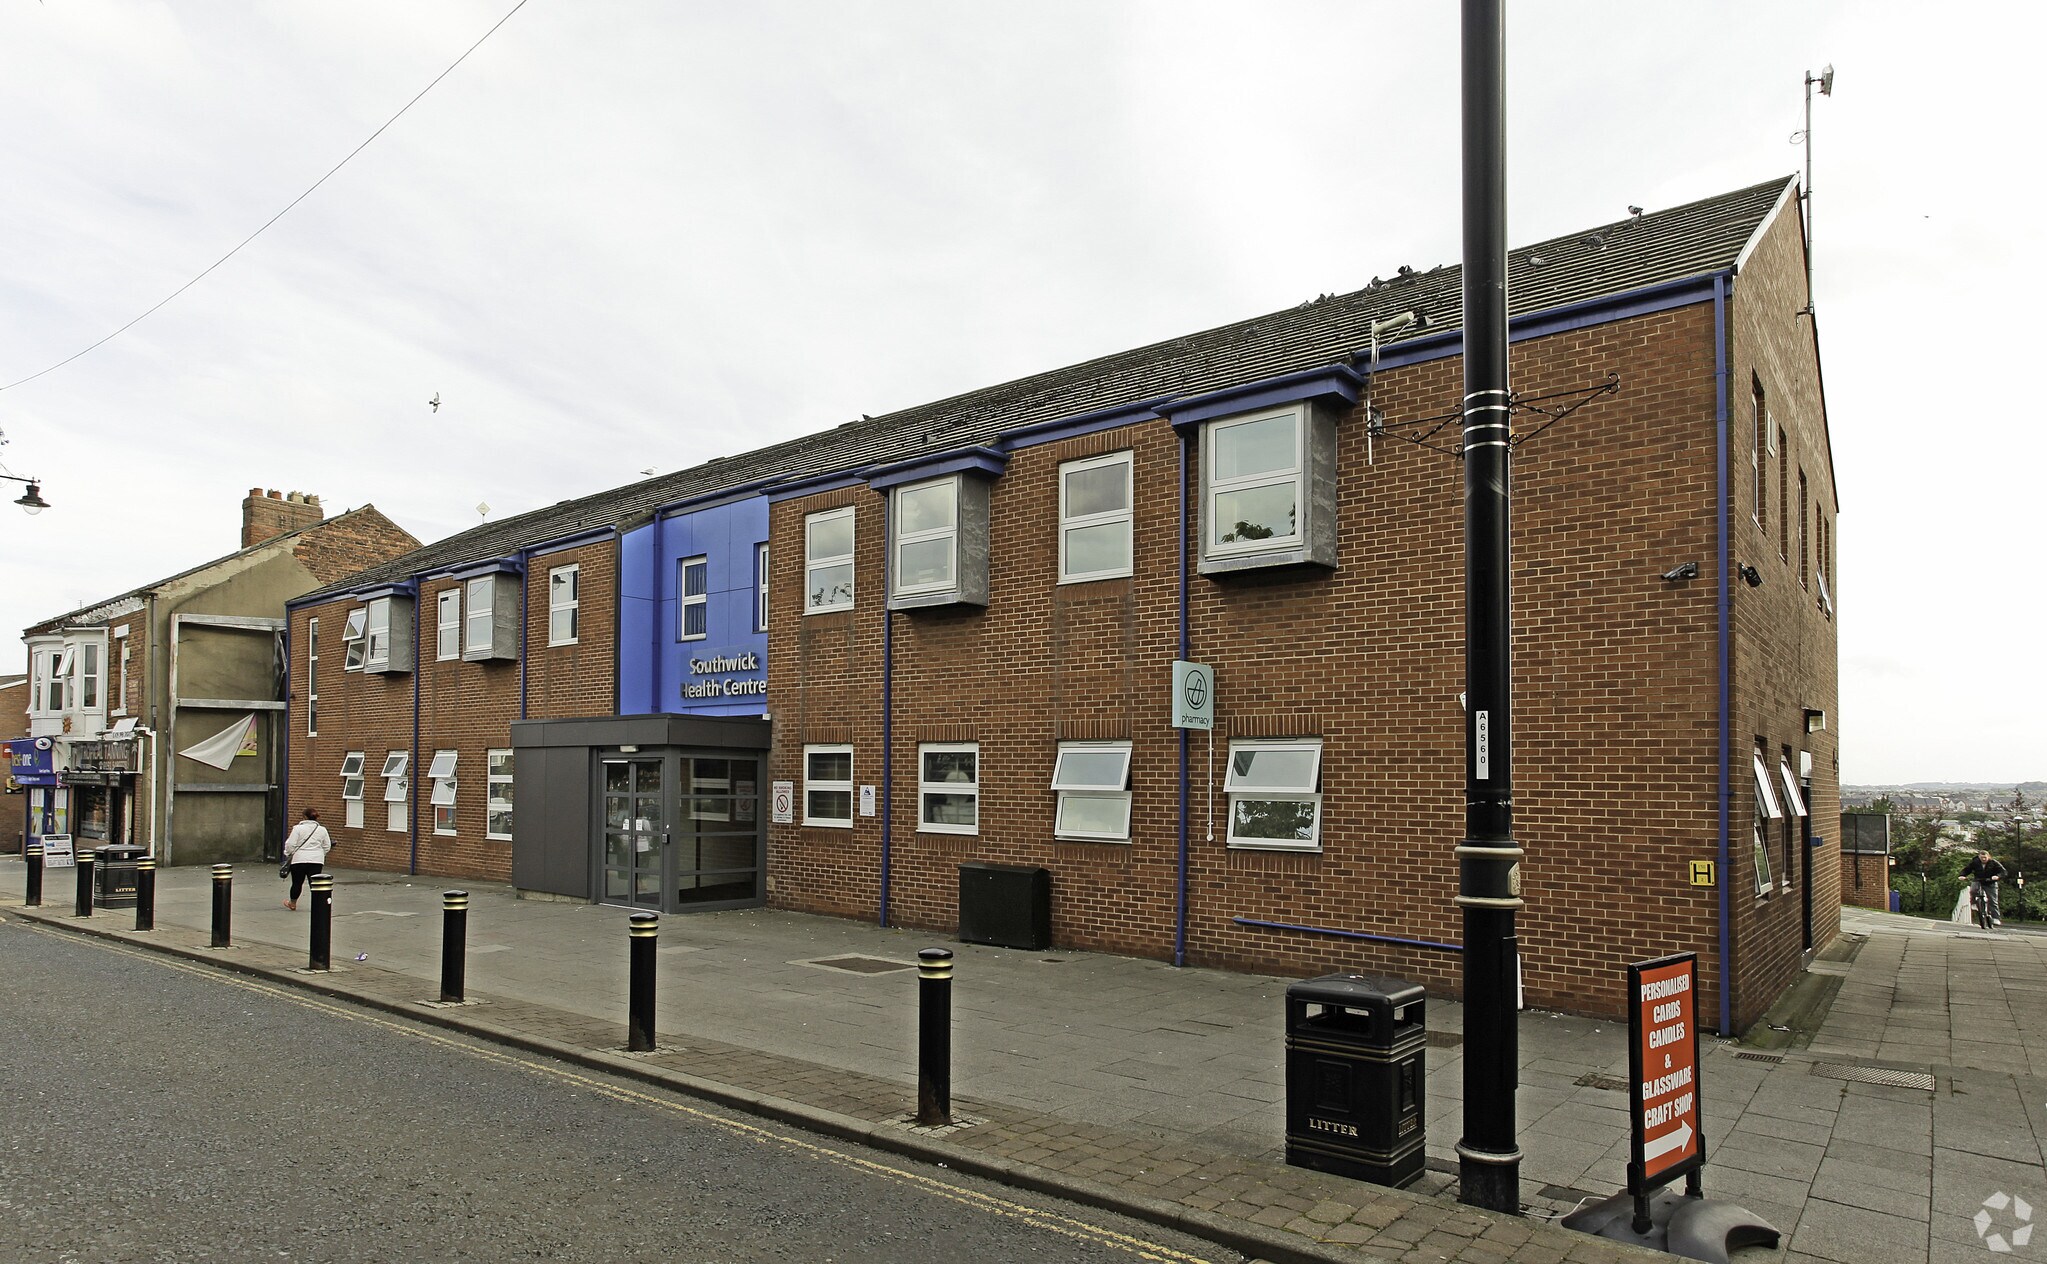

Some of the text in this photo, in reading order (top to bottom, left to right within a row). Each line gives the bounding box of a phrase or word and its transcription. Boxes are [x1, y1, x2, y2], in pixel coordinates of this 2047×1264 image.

[689, 651, 758, 675] Southwick
[723, 678, 767, 696] Centre
[1181, 713, 1210, 727] pharmacy
[1693, 864, 1711, 883] H
[1641, 973, 1690, 1002] PERSONALISED
[1653, 999, 1681, 1024] CARDS
[1649, 1021, 1685, 1049] CANDLES
[1664, 1053, 1672, 1069] &
[1642, 1065, 1692, 1101] GLASSWARE
[1644, 1091, 1693, 1130] CRAFT SHOP
[1308, 1118, 1359, 1137] LITTER
